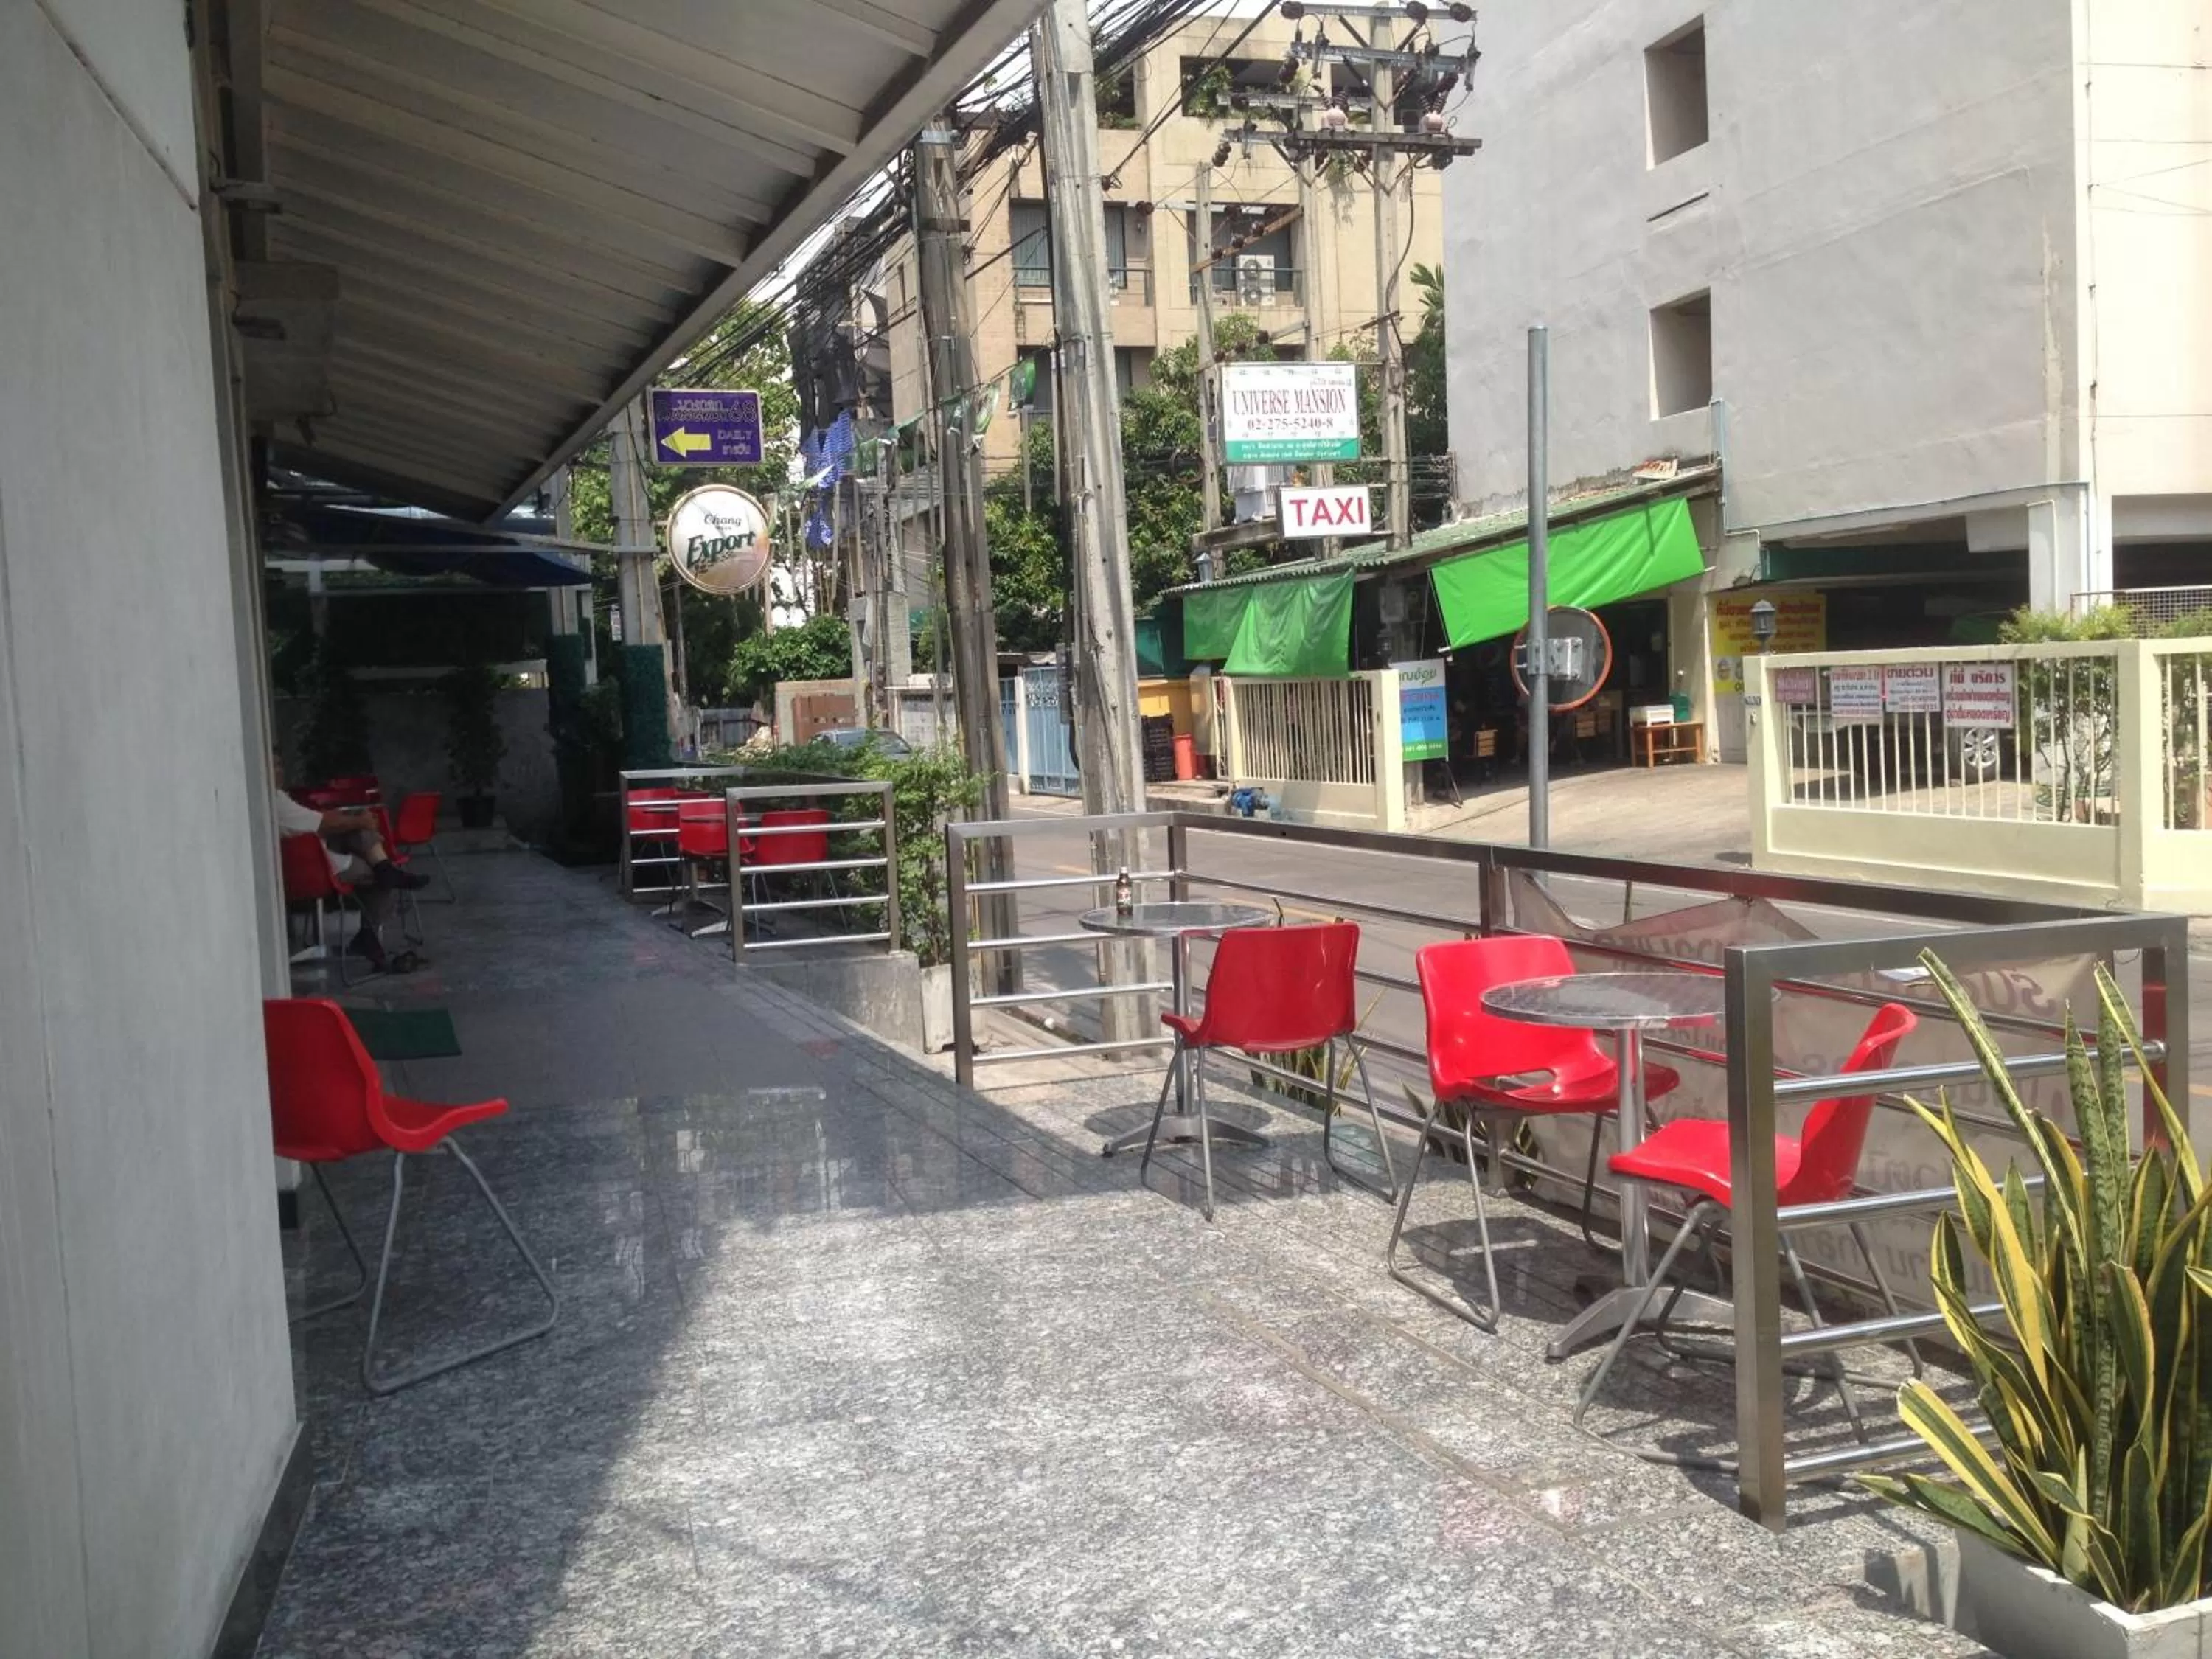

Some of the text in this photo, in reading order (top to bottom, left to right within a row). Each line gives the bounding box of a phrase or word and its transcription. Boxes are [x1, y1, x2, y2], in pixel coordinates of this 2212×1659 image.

[1232, 388, 1346, 415] UNIVERSE MANSION
[1247, 417, 1334, 431] 02-275-5240-8
[717, 429, 753, 441] DAILY
[704, 513, 742, 527] Chang
[1289, 496, 1364, 527] TAXI
[686, 530, 757, 568] Export
